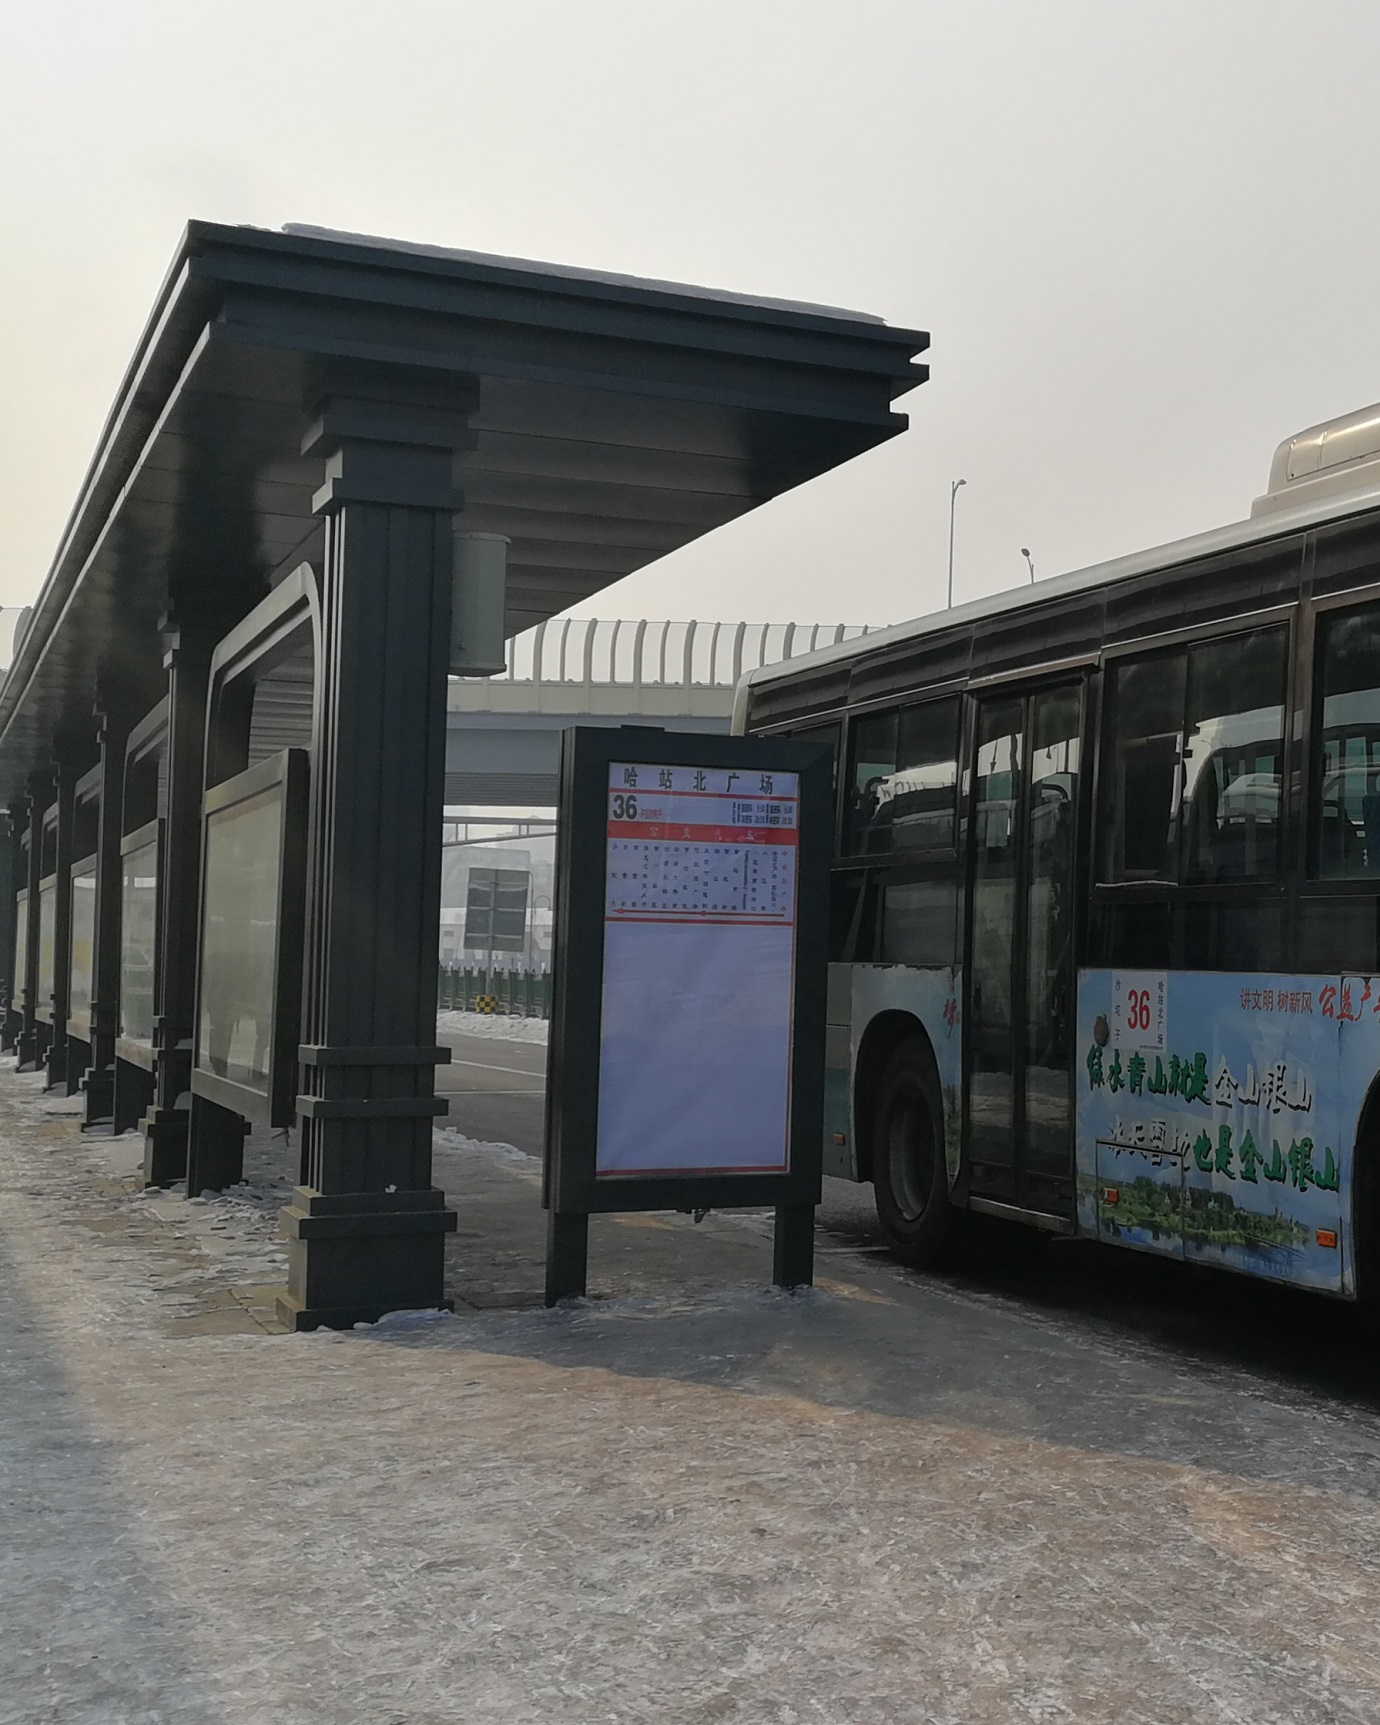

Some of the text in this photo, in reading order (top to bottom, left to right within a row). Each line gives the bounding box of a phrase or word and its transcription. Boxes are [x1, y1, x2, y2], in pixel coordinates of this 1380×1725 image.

[623, 766, 774, 796] 哈站北广场
[612, 794, 638, 820] 36
[1127, 989, 1150, 1030] 36
[1240, 987, 1274, 1011] 讲文明
[1277, 989, 1313, 1014] 树新风
